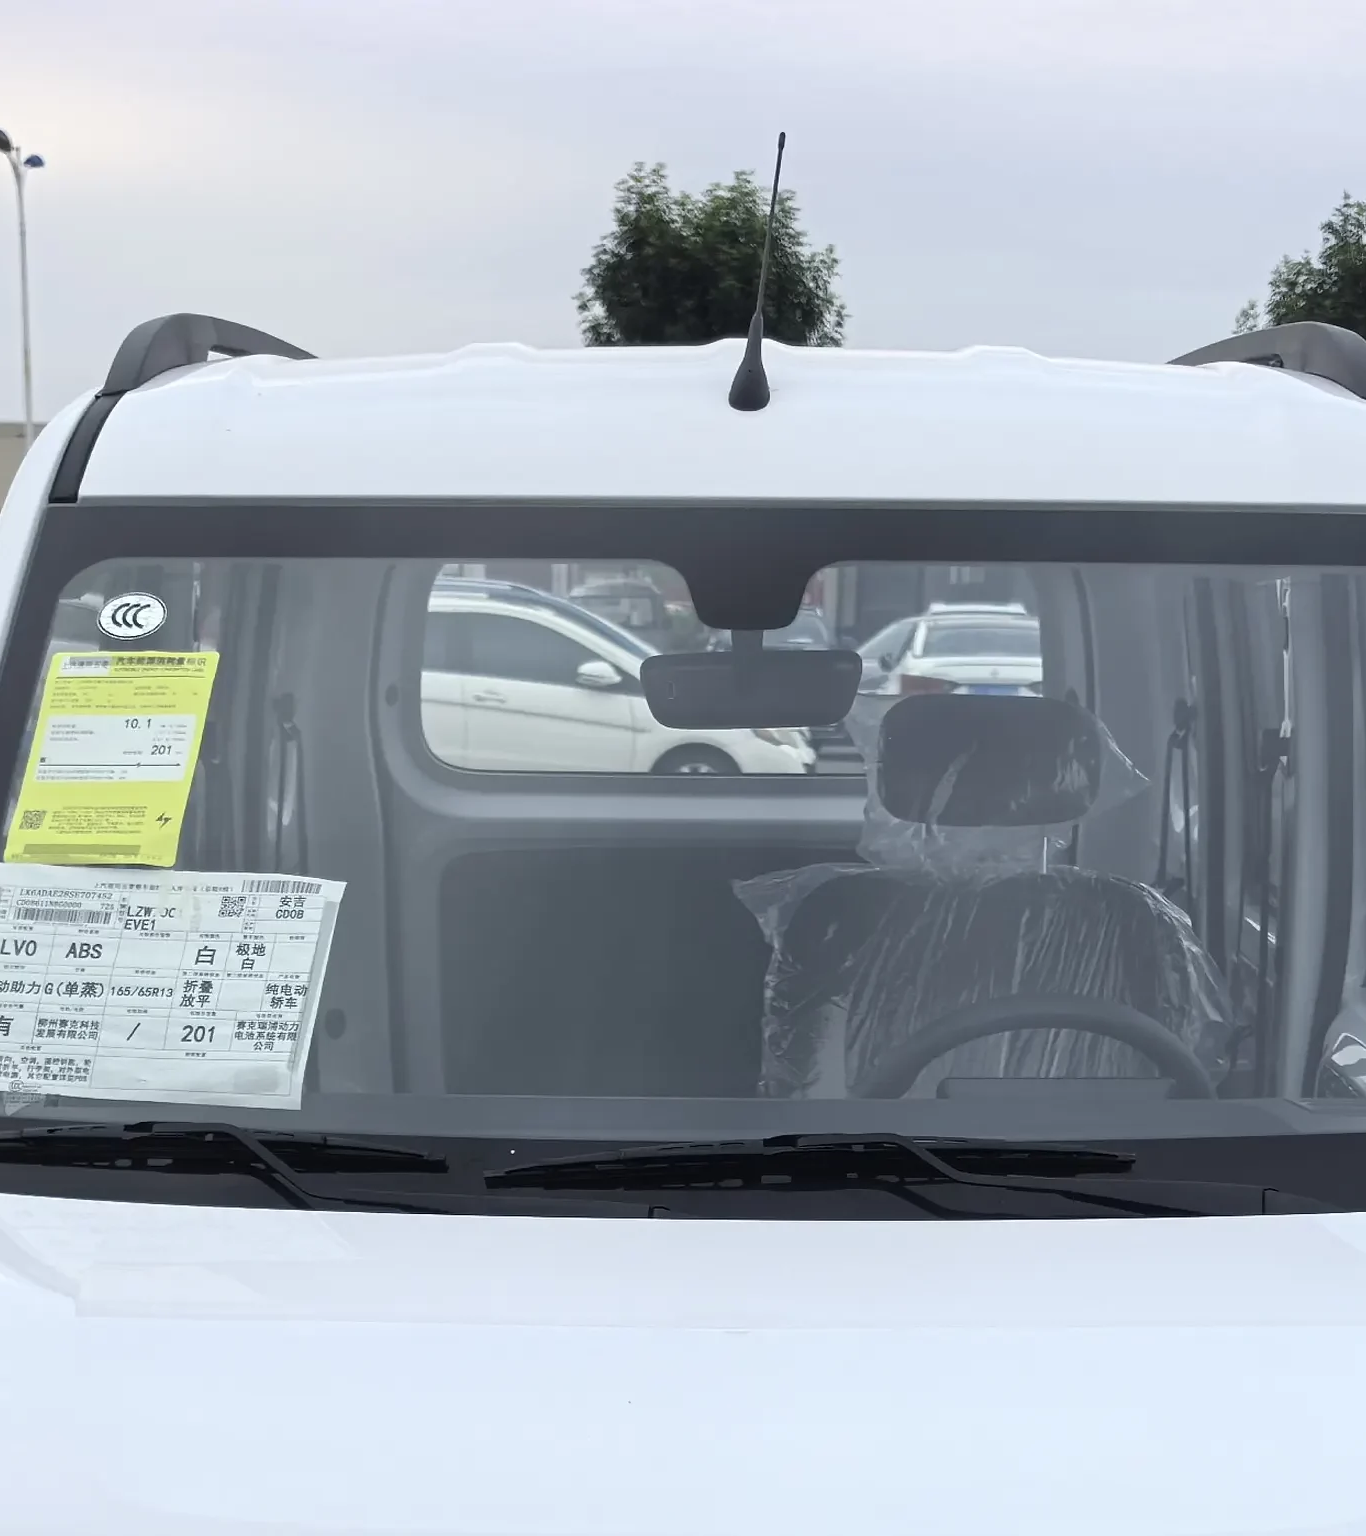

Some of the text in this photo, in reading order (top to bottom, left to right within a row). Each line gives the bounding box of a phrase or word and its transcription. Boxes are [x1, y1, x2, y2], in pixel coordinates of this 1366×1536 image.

[125, 718, 152, 729] 10.1
[150, 745, 172, 756] 201
[124, 918, 156, 931] EVE1
[65, 942, 103, 960] ABS
[194, 945, 217, 966] 白
[235, 943, 267, 957] 极地
[241, 957, 255, 971] 白
[110, 986, 174, 998] 165/65R13
[183, 980, 214, 994] 折叠
[264, 983, 308, 997] 纯电动
[179, 994, 211, 1008] 放平
[269, 997, 298, 1010] 轿车
[35, 1028, 99, 1041] 发展有限公司
[181, 1025, 216, 1043] 201
[234, 1031, 297, 1042] 电池系统有限
[253, 1041, 274, 1052] 公司
